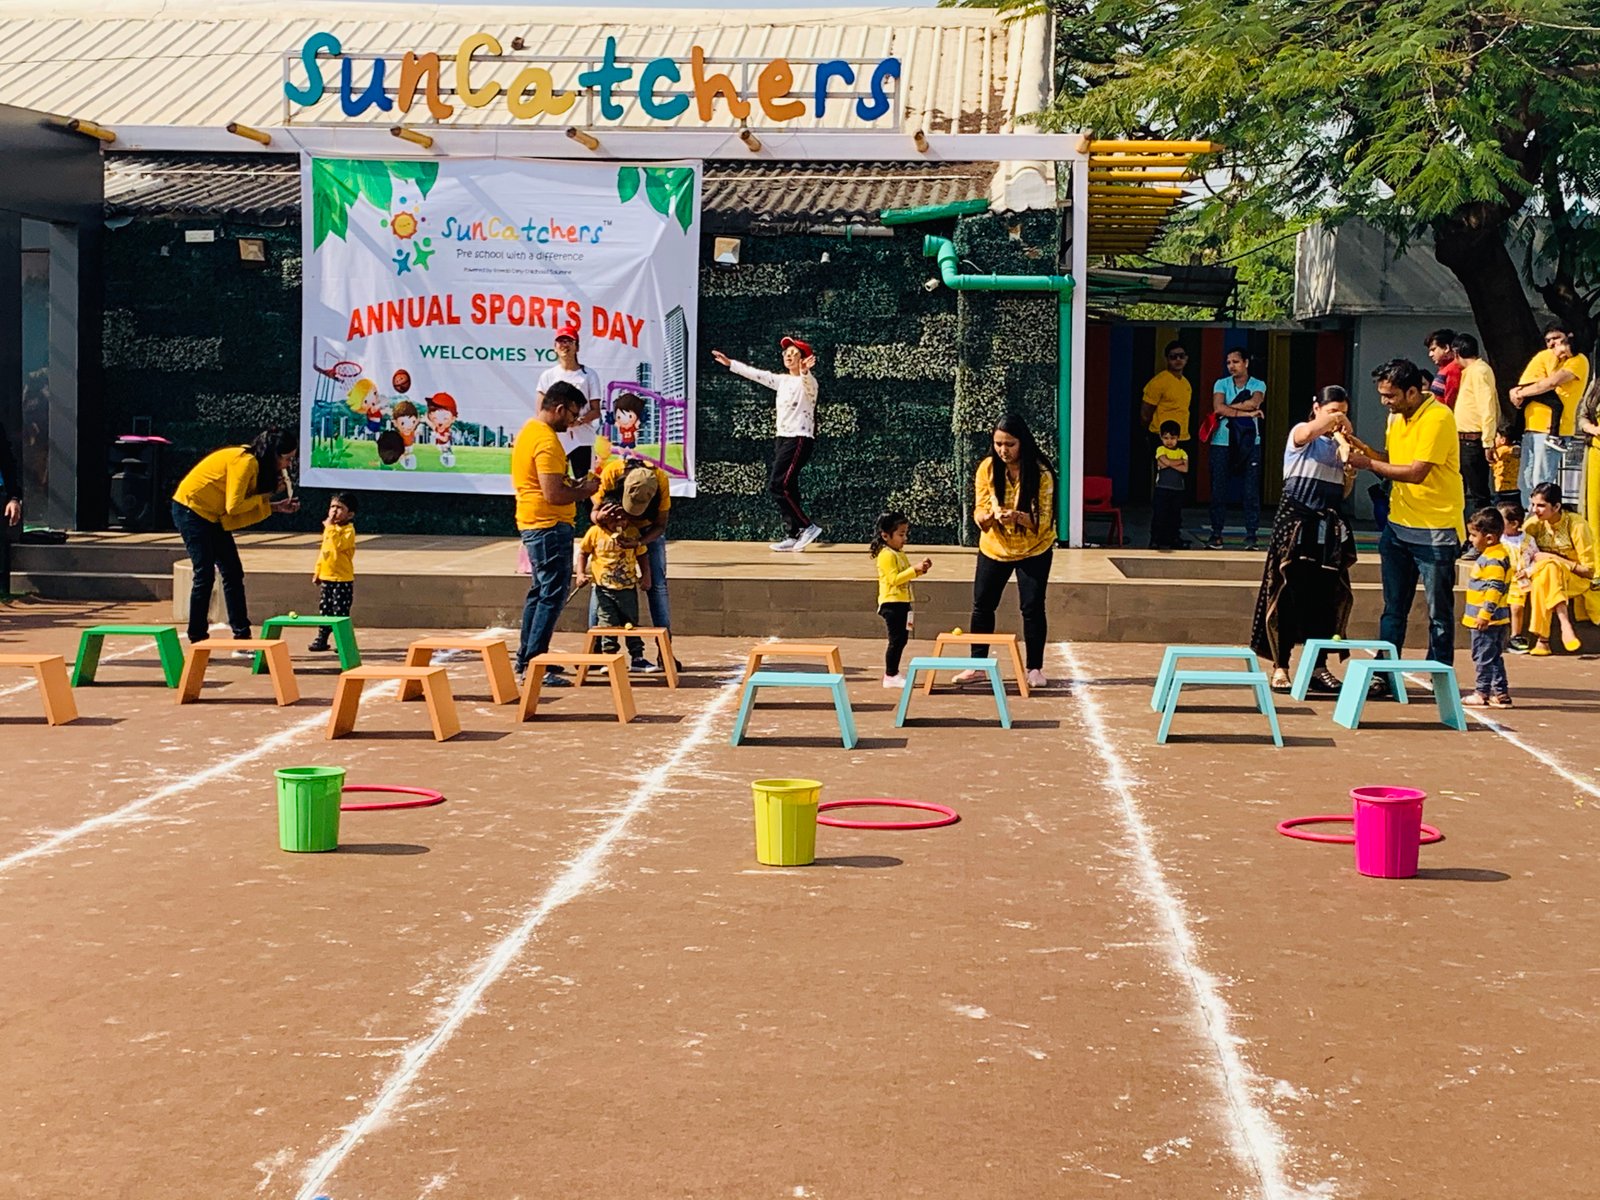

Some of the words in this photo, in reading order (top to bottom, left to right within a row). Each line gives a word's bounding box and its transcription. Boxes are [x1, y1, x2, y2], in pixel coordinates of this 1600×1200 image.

[284, 32, 901, 122] SunCatchers
[441, 216, 604, 244] SunCatchers
[456, 248, 472, 259] Pre
[474, 250, 504, 259] school
[506, 251, 526, 261] with
[528, 252, 534, 260] a
[535, 251, 584, 262] difference
[346, 293, 461, 342] ANNUAL
[470, 293, 582, 332] SPORTS
[592, 305, 645, 348] DAY
[419, 344, 526, 362] WELCOMES
[534, 348, 559, 362] YO
